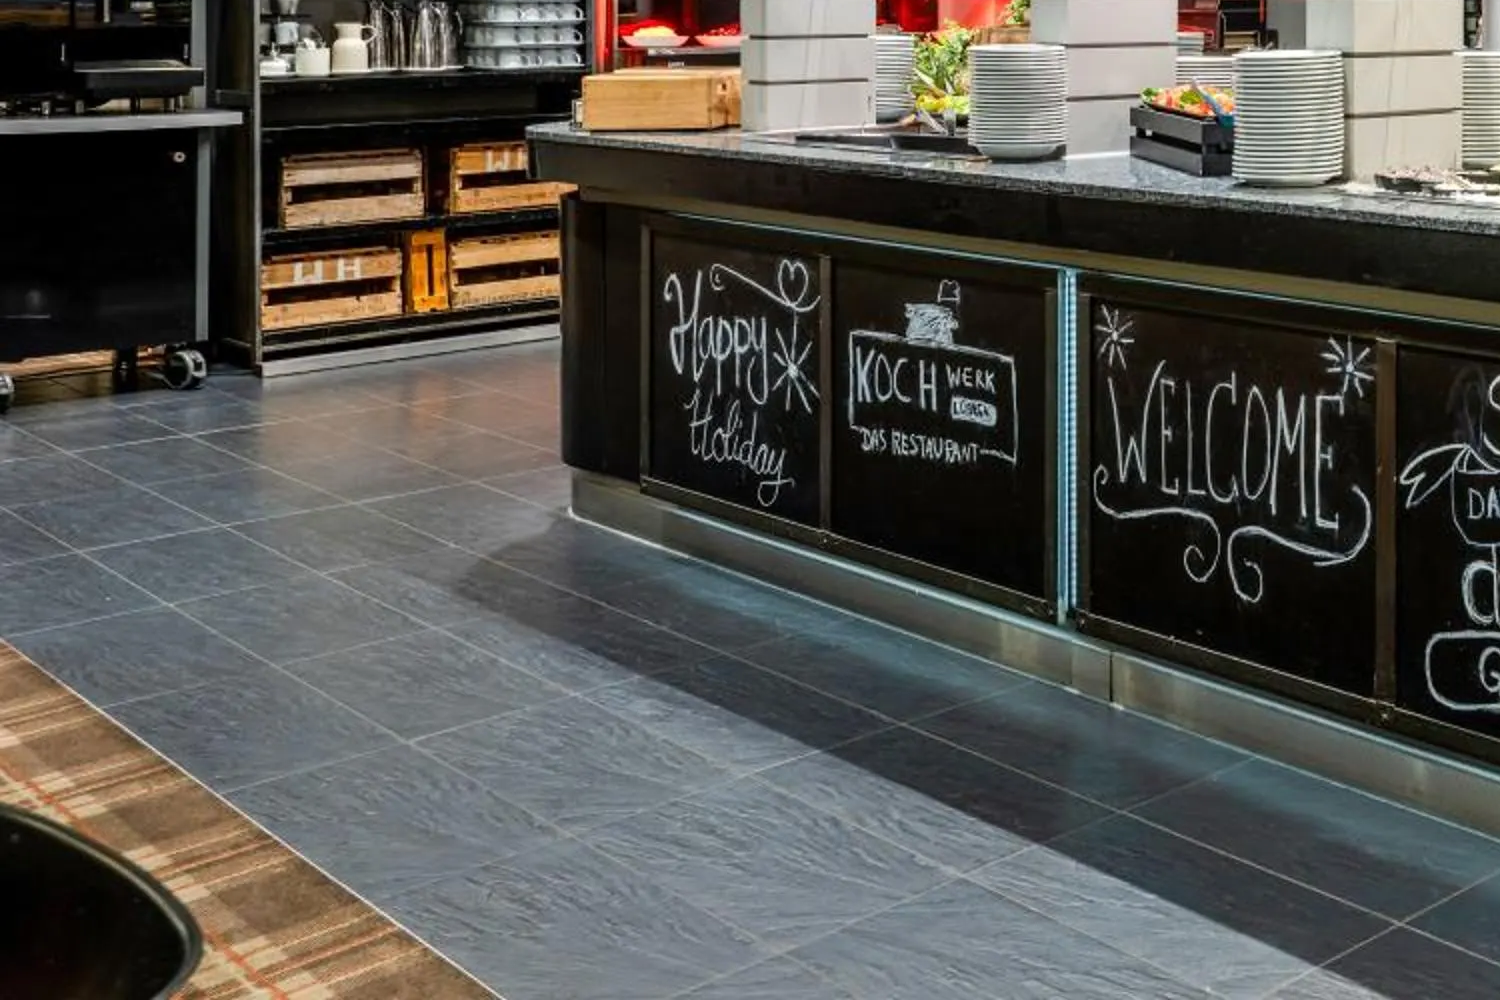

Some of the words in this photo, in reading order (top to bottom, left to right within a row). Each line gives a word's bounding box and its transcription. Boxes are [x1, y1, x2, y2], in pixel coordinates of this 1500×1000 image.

[664, 269, 768, 405] Happy
[855, 345, 938, 412] KOCH
[945, 364, 998, 395] WERK
[684, 389, 795, 507] Holiday
[861, 429, 887, 452] DAS
[891, 430, 980, 464] RESTAURANT
[1107, 359, 1344, 530] WELCOME
